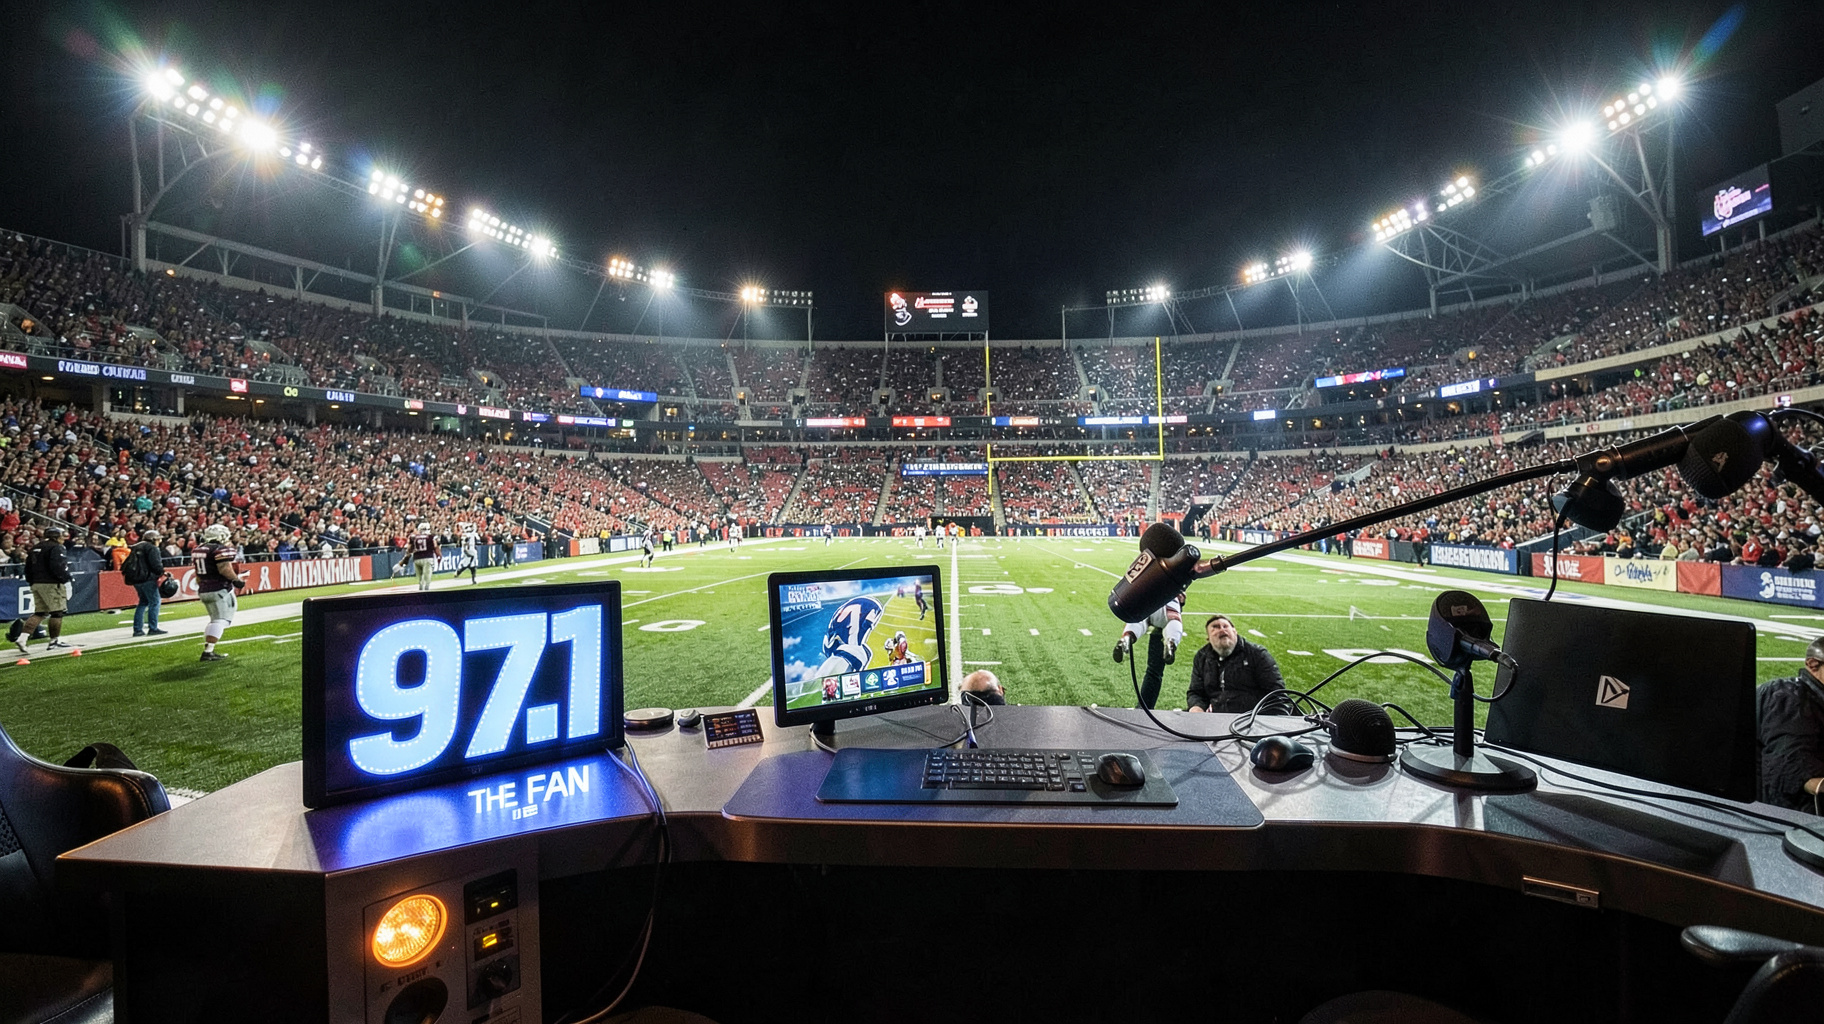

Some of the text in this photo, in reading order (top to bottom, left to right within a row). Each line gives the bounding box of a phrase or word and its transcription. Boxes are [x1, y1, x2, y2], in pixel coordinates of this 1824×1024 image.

[349, 604, 603, 775] 97.1
[467, 782, 518, 814] THE
[527, 765, 589, 804] FAN
